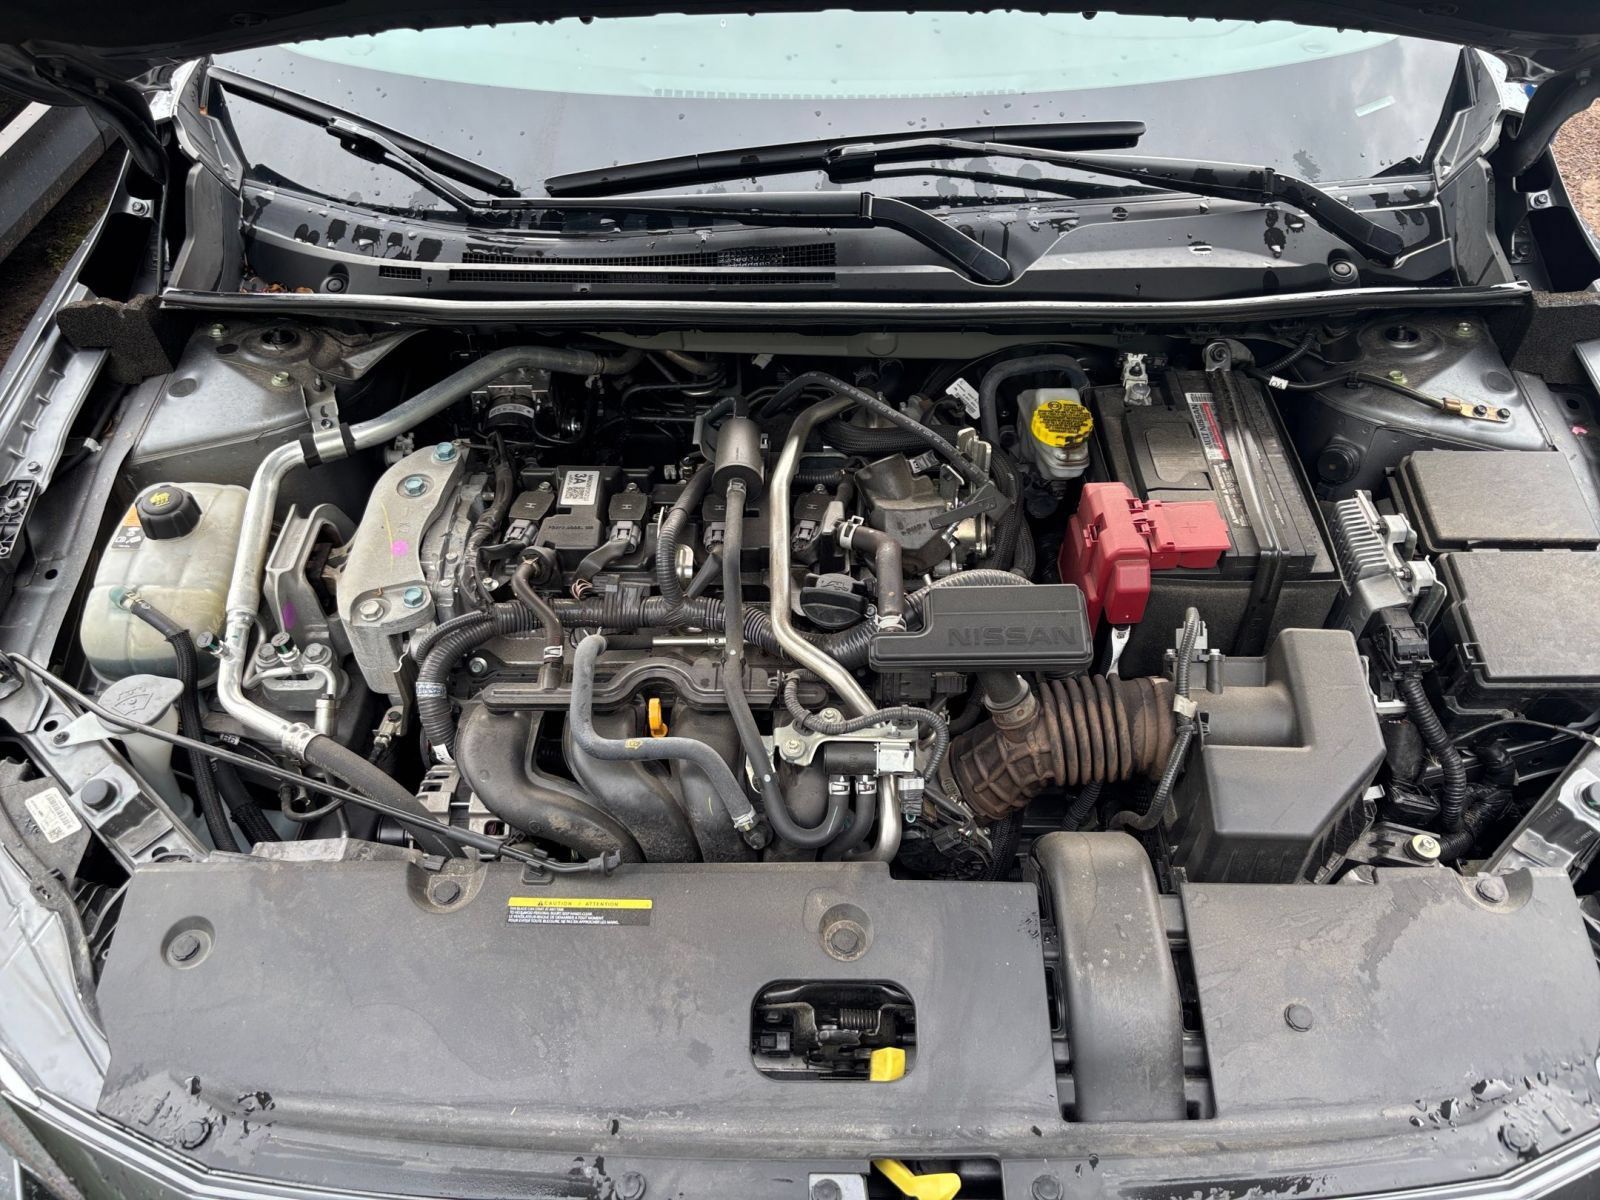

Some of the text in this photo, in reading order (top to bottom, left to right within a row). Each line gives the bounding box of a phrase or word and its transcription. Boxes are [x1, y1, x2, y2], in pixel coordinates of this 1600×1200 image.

[1191, 404, 1206, 431] NISSAN
[573, 473, 587, 485] 3A
[948, 626, 1077, 646] NISSAN
